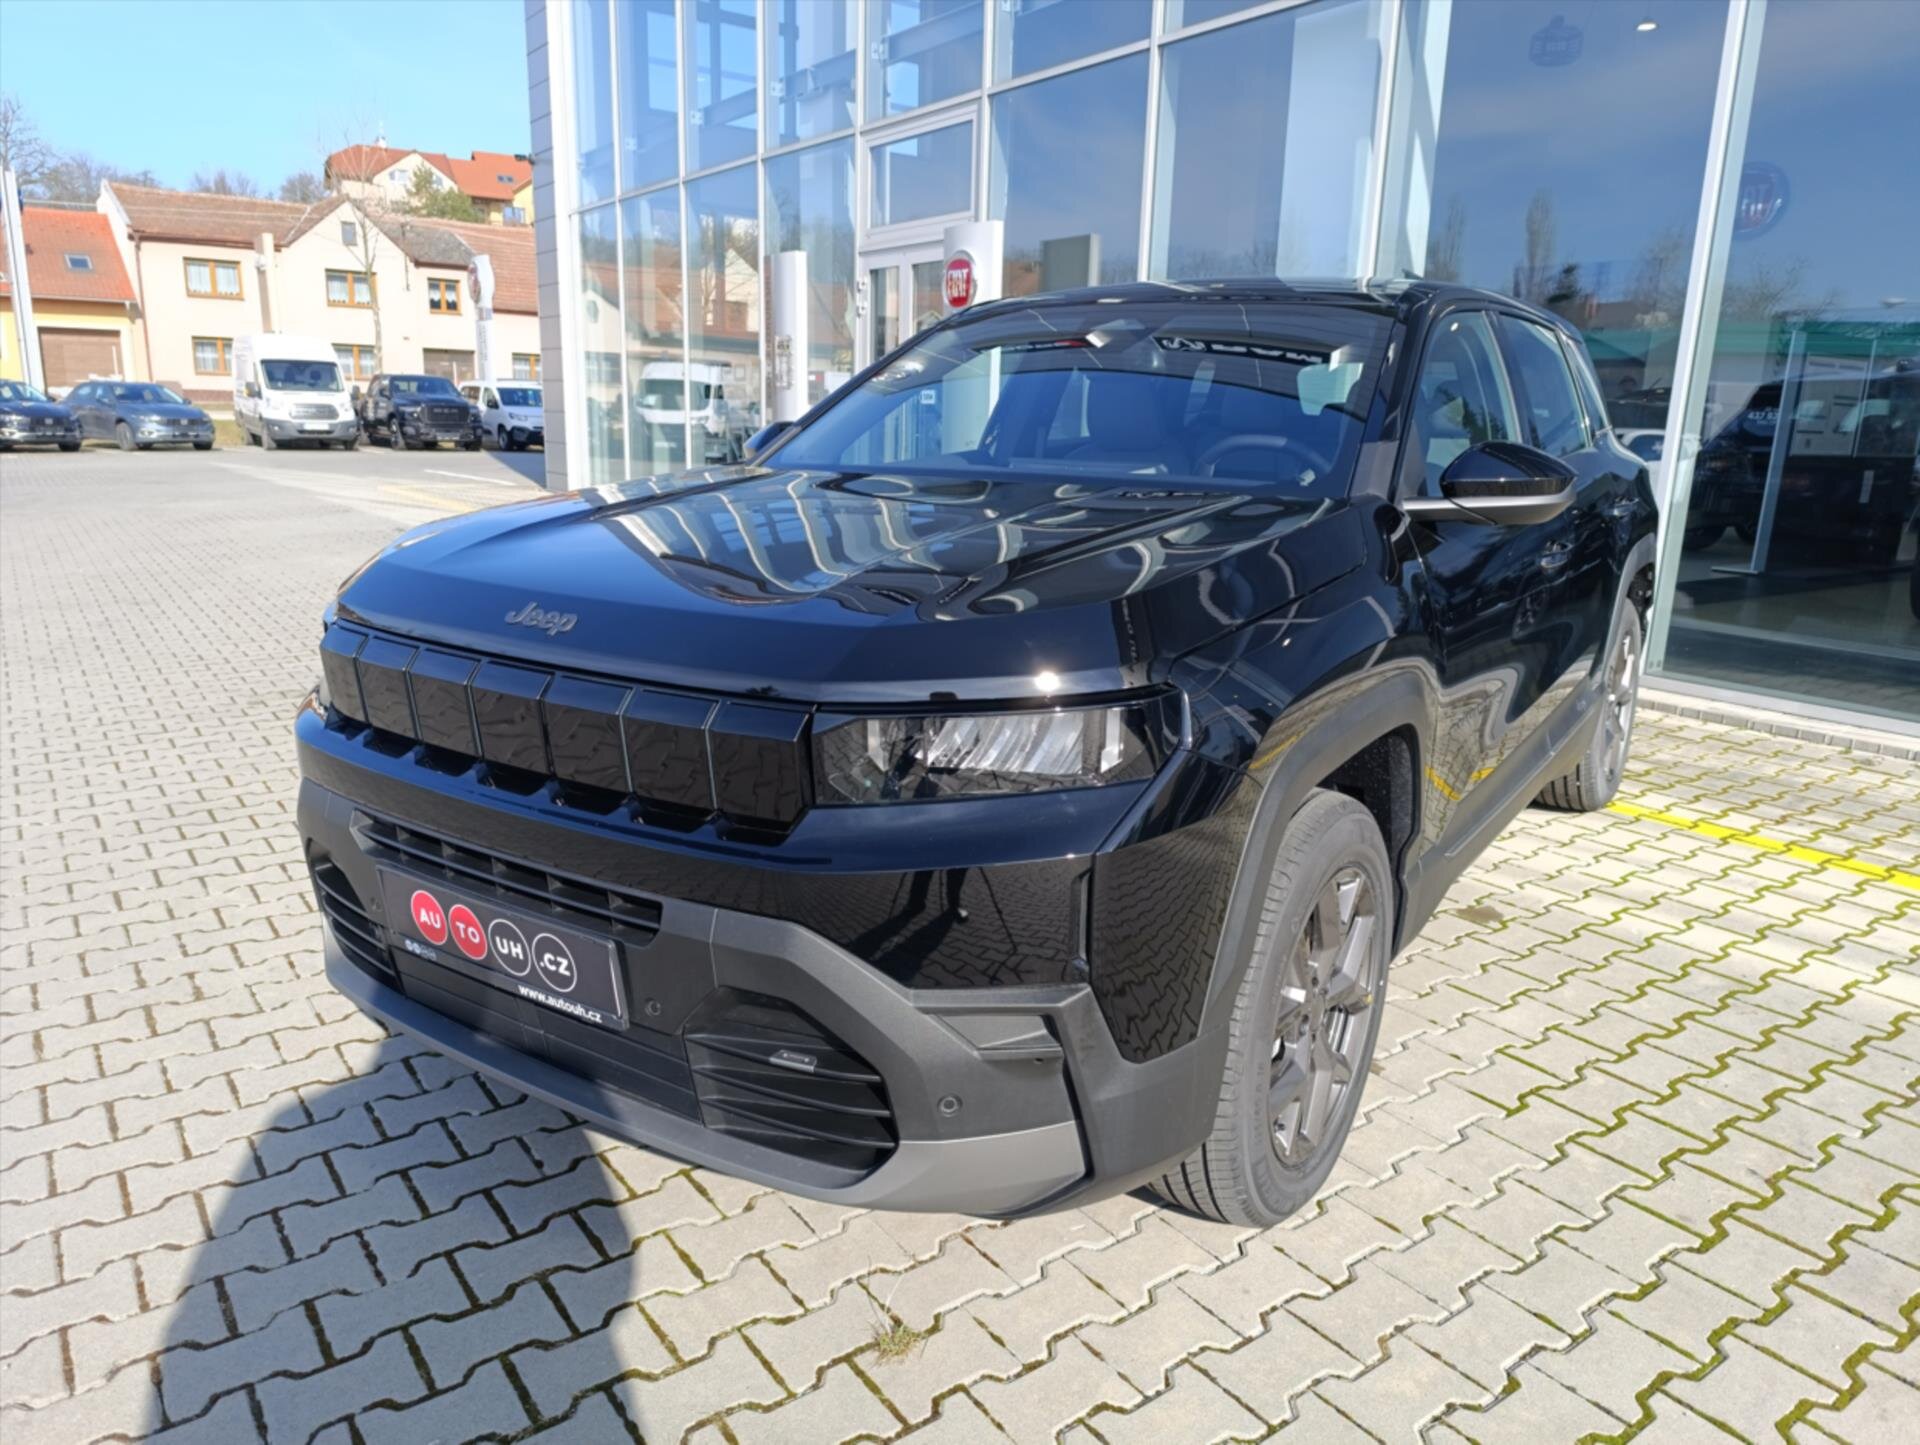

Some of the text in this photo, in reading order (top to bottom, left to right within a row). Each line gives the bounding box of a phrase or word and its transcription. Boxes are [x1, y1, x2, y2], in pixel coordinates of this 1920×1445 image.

[504, 601, 578, 636] Jeep
[419, 908, 441, 929] AU
[455, 921, 480, 944] TO
[495, 936, 524, 960] UH
[518, 984, 603, 1024] www.autouh.cz
